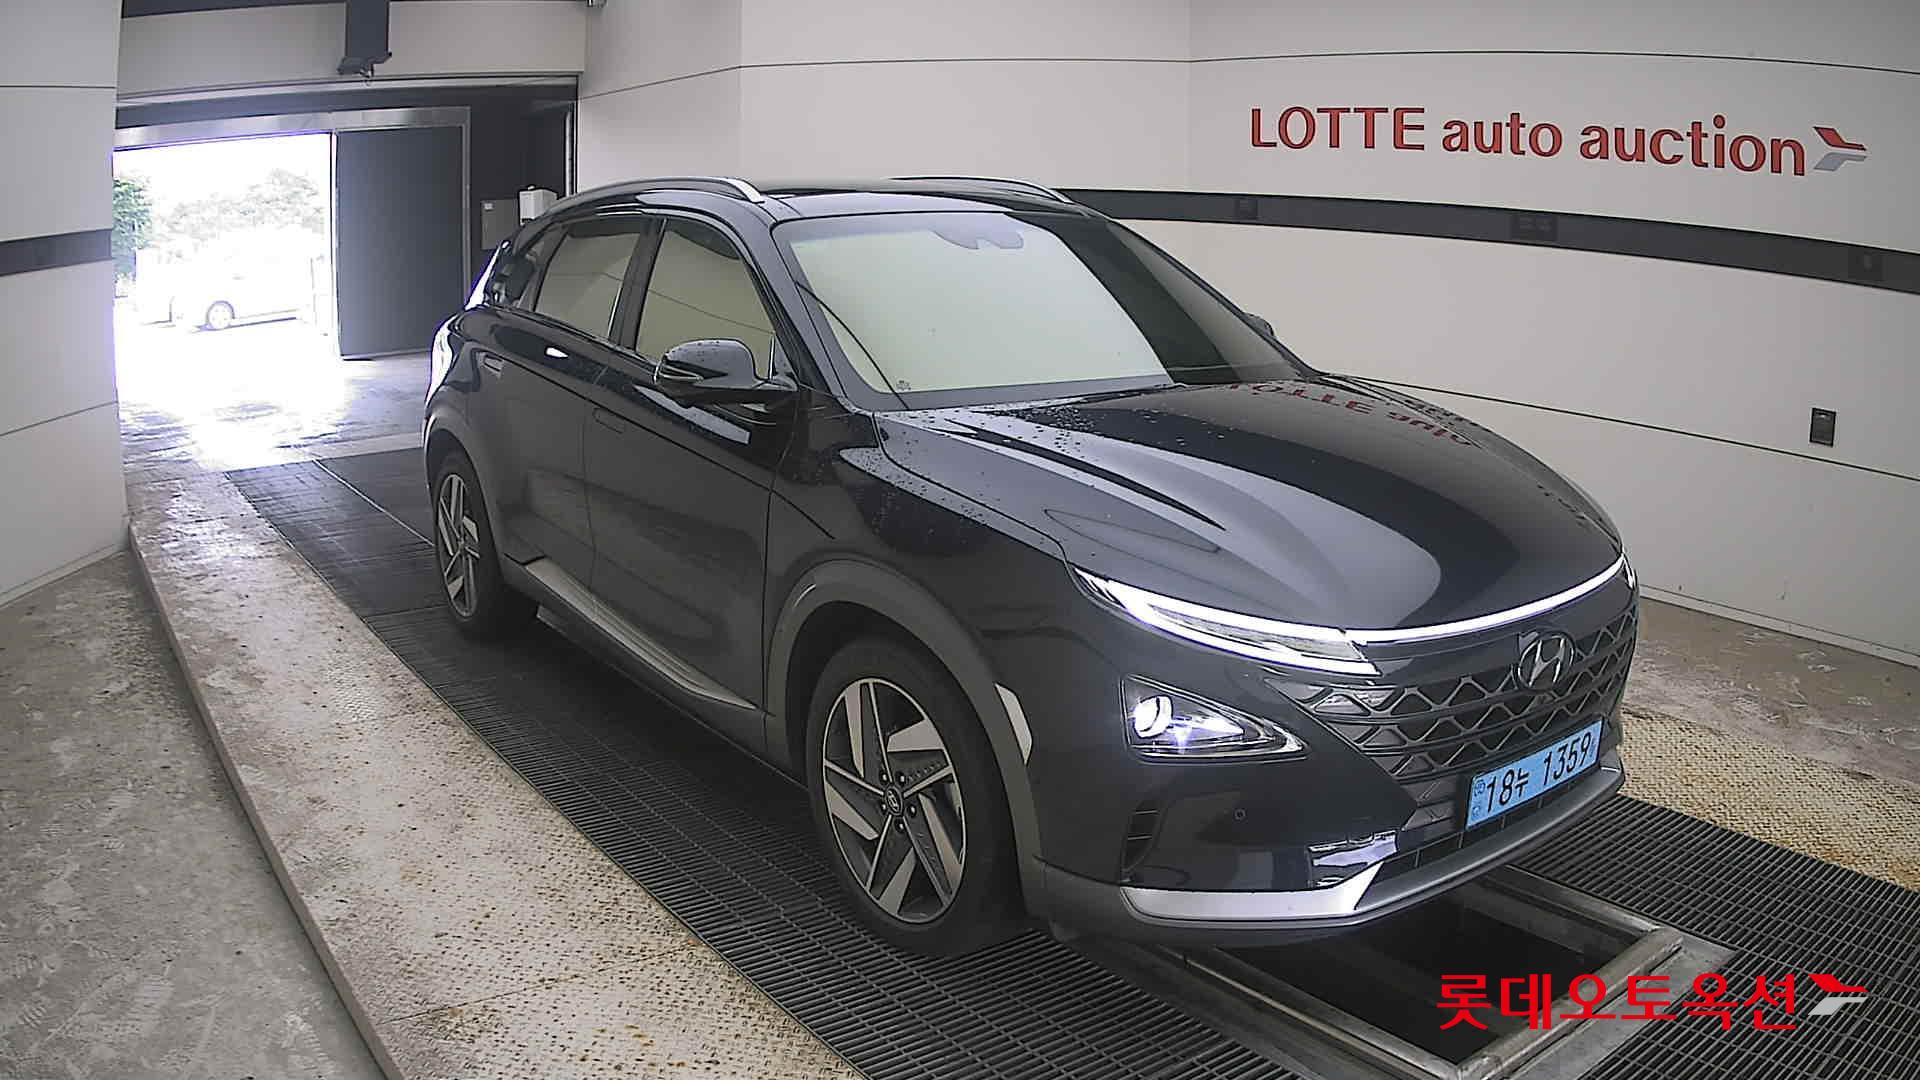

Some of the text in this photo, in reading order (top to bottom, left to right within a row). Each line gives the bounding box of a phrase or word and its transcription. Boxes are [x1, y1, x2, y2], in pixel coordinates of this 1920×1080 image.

[1249, 105, 1807, 177] LOTTE auto auction
[1486, 767, 1530, 813] 18누
[1543, 731, 1592, 786] 1359
